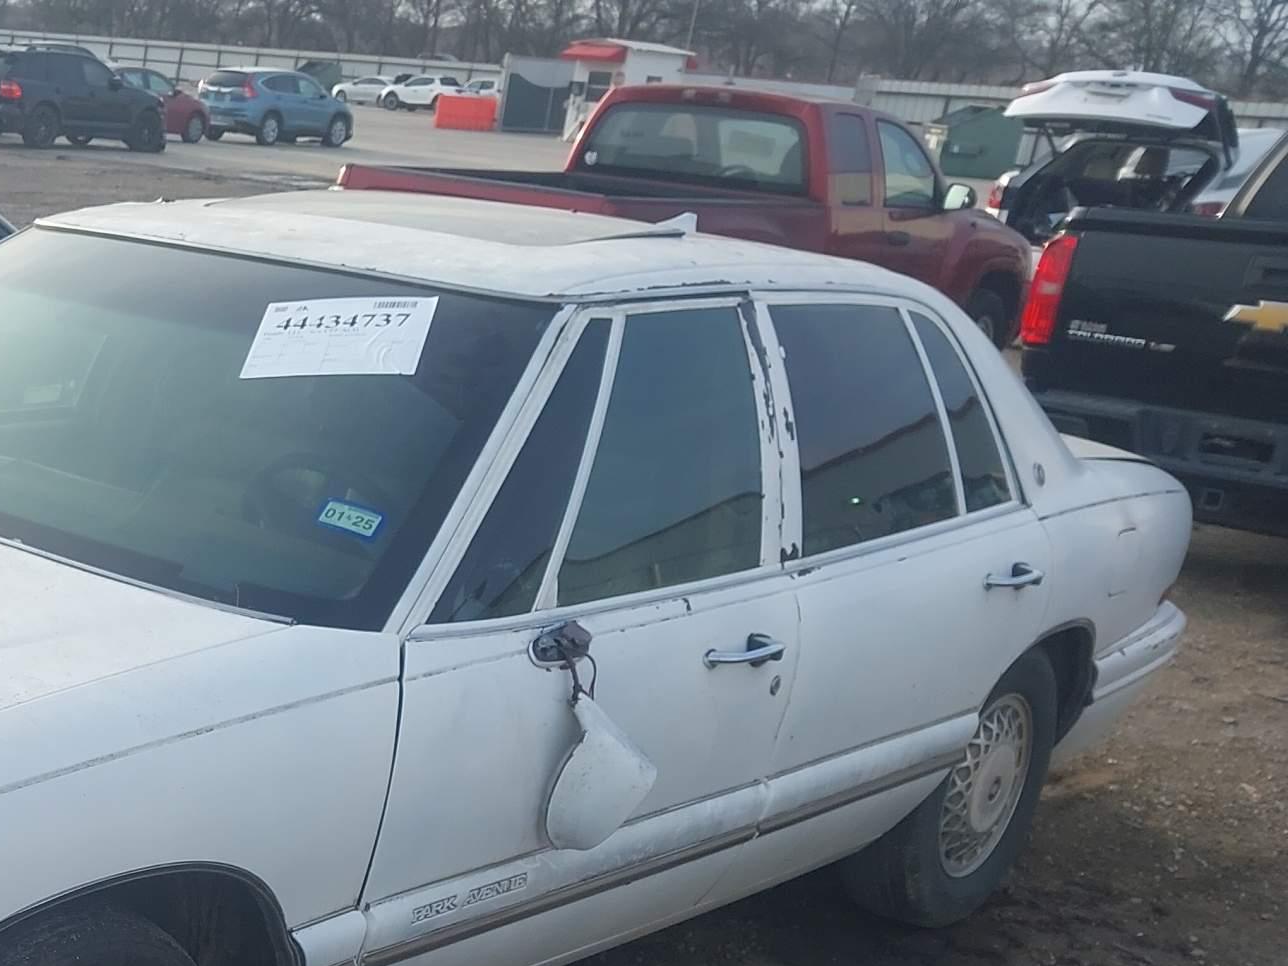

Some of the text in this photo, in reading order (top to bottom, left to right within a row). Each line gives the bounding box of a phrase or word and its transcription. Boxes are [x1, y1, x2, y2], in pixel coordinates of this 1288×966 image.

[274, 312, 412, 331] 44434737
[410, 872, 529, 926] PARK AVENUE
